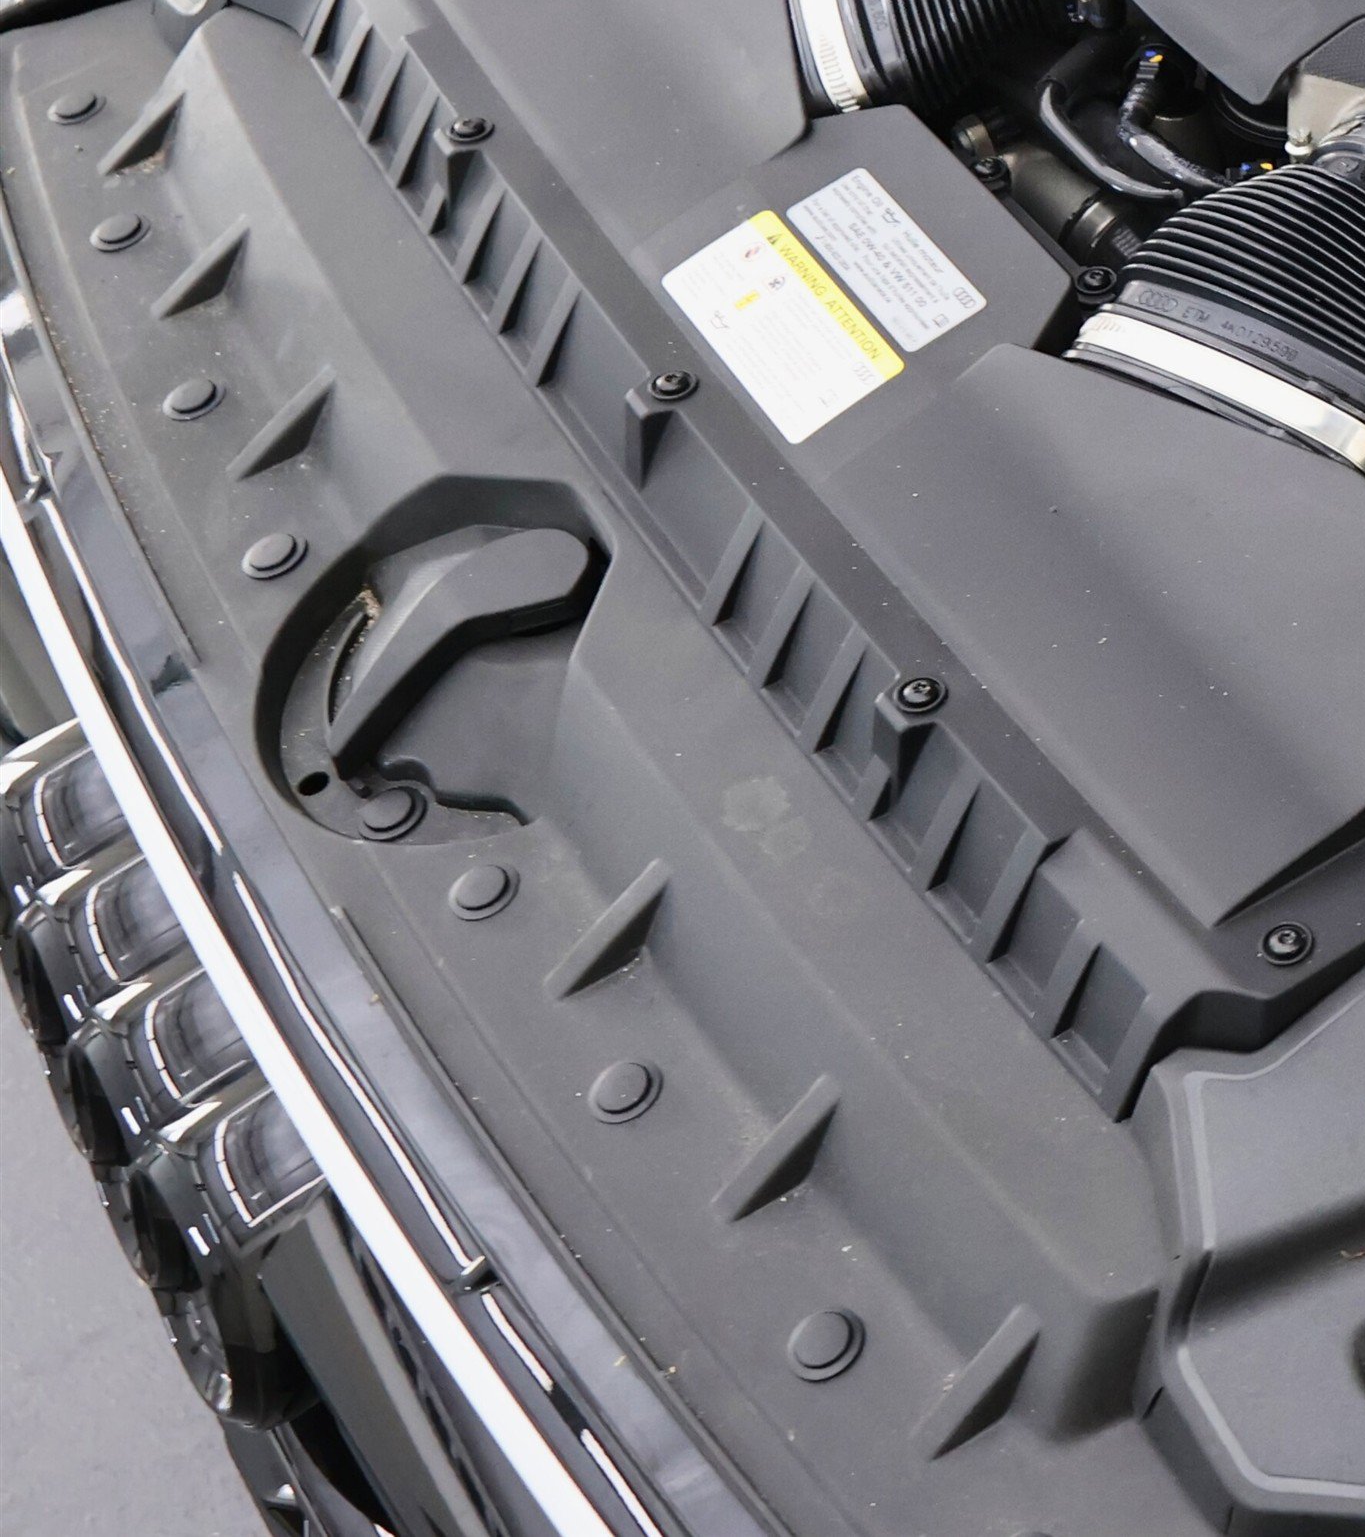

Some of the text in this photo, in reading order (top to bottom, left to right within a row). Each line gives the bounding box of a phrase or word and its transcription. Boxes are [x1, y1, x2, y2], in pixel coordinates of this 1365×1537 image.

[847, 222, 865, 239] SAE
[888, 267, 906, 283] VW
[777, 243, 828, 297] WARNING
[824, 297, 882, 360] ATTENTION
